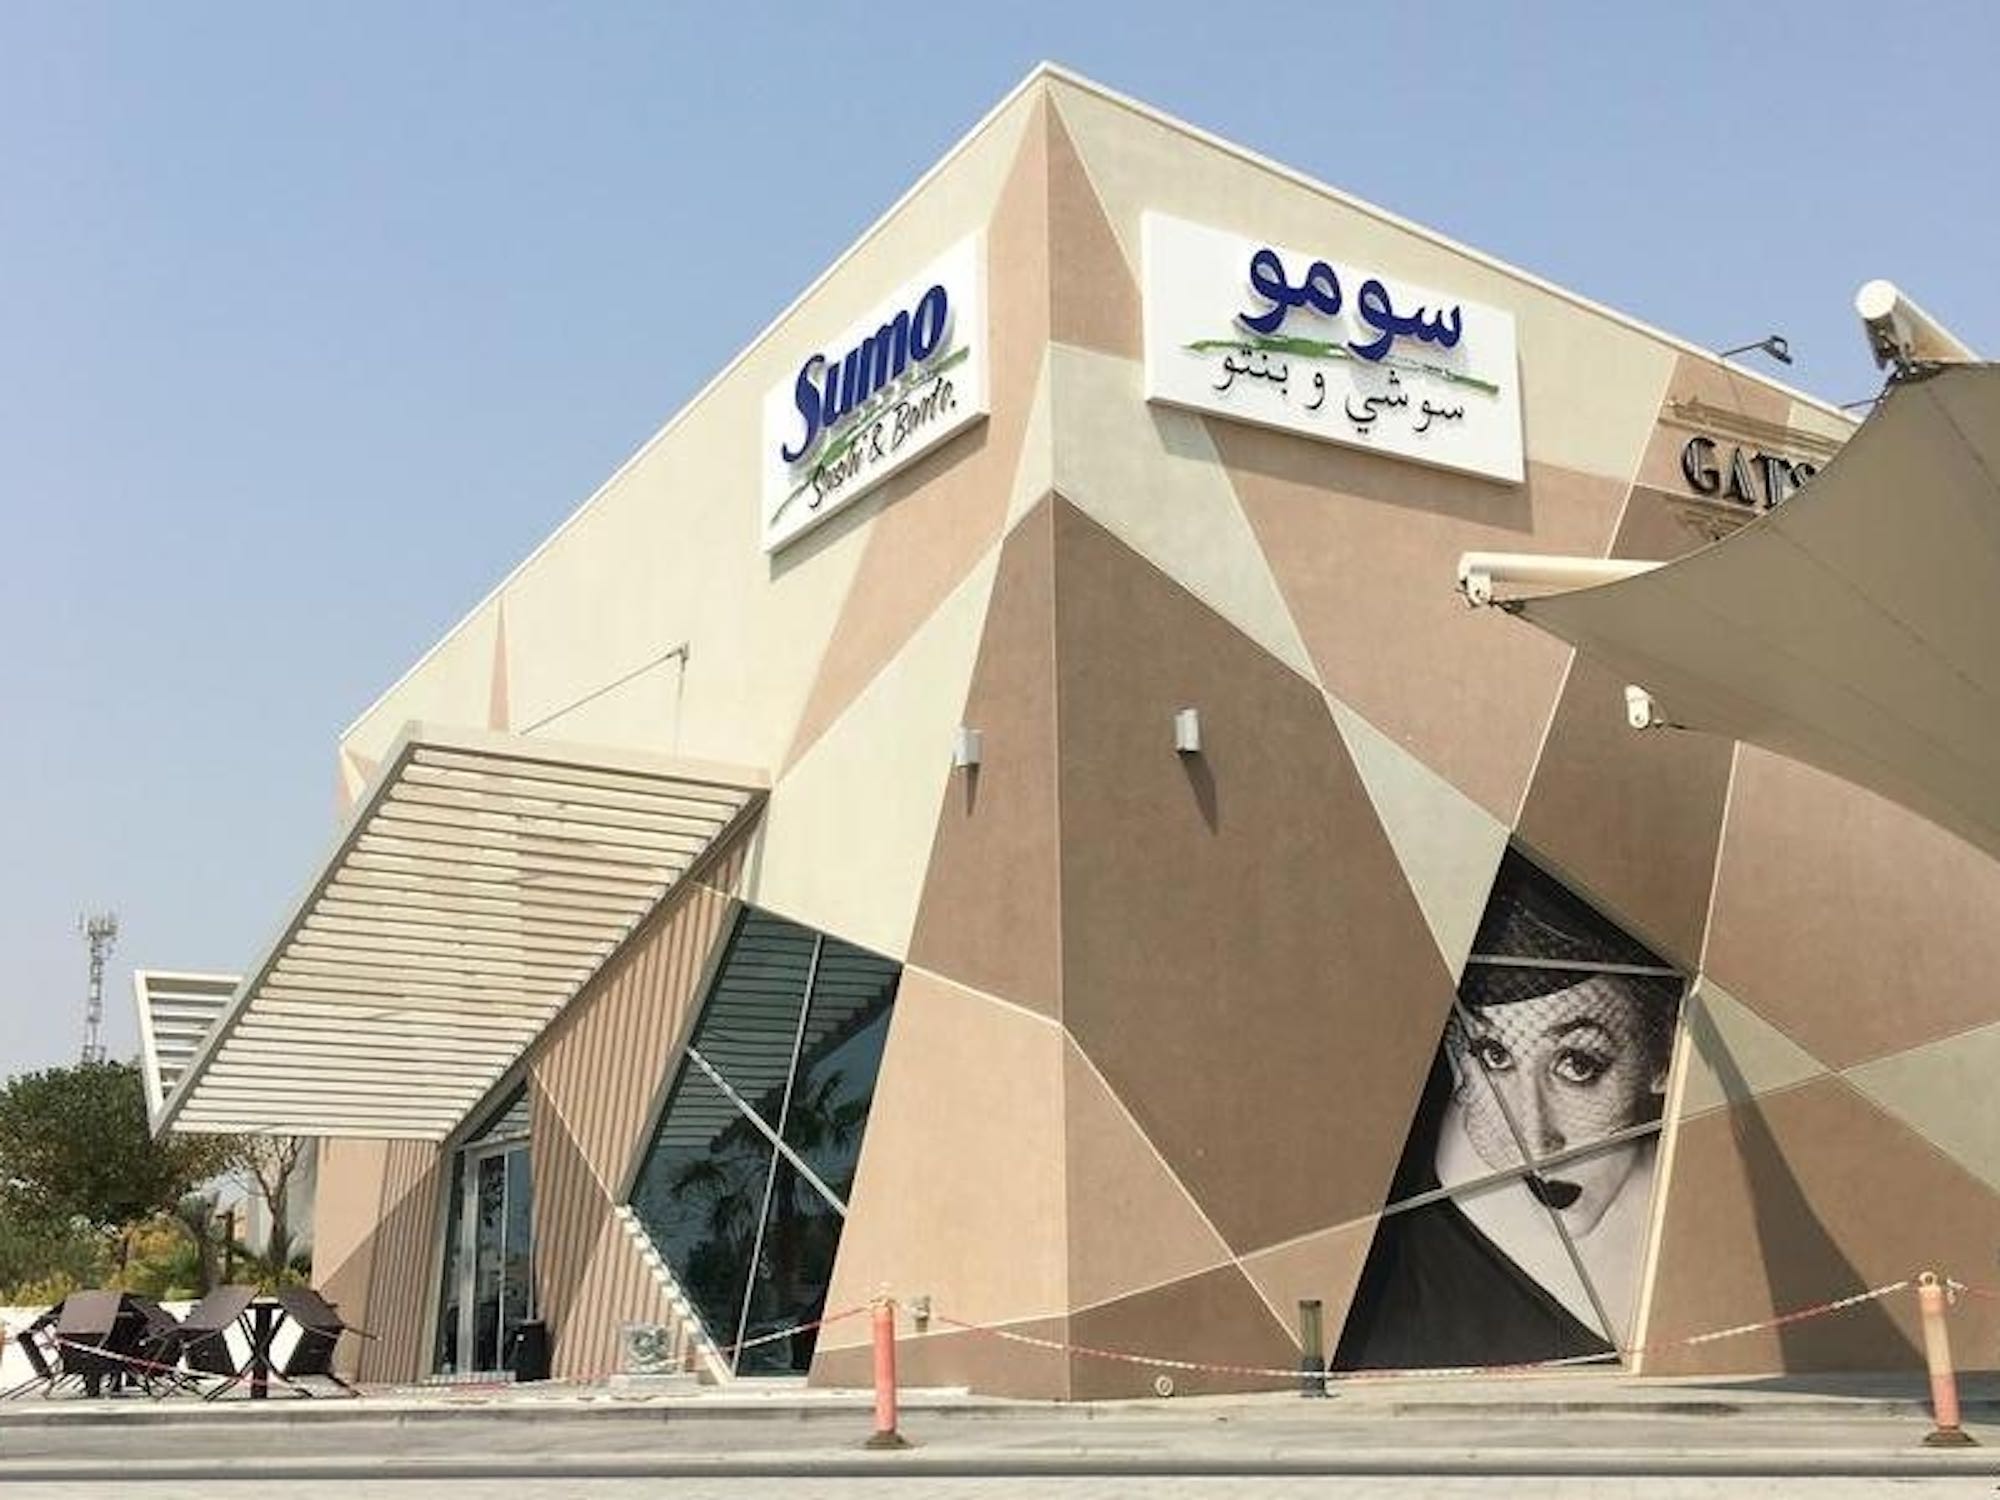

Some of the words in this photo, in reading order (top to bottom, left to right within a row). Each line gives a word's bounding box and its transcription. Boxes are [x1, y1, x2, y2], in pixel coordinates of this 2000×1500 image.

[1238, 249, 1463, 362] سومو
[781, 284, 948, 463] Sumo
[1212, 346, 1289, 395] بنتو
[1304, 370, 1326, 410] و
[1345, 369, 1465, 433] سوشي
[867, 422, 885, 463] &
